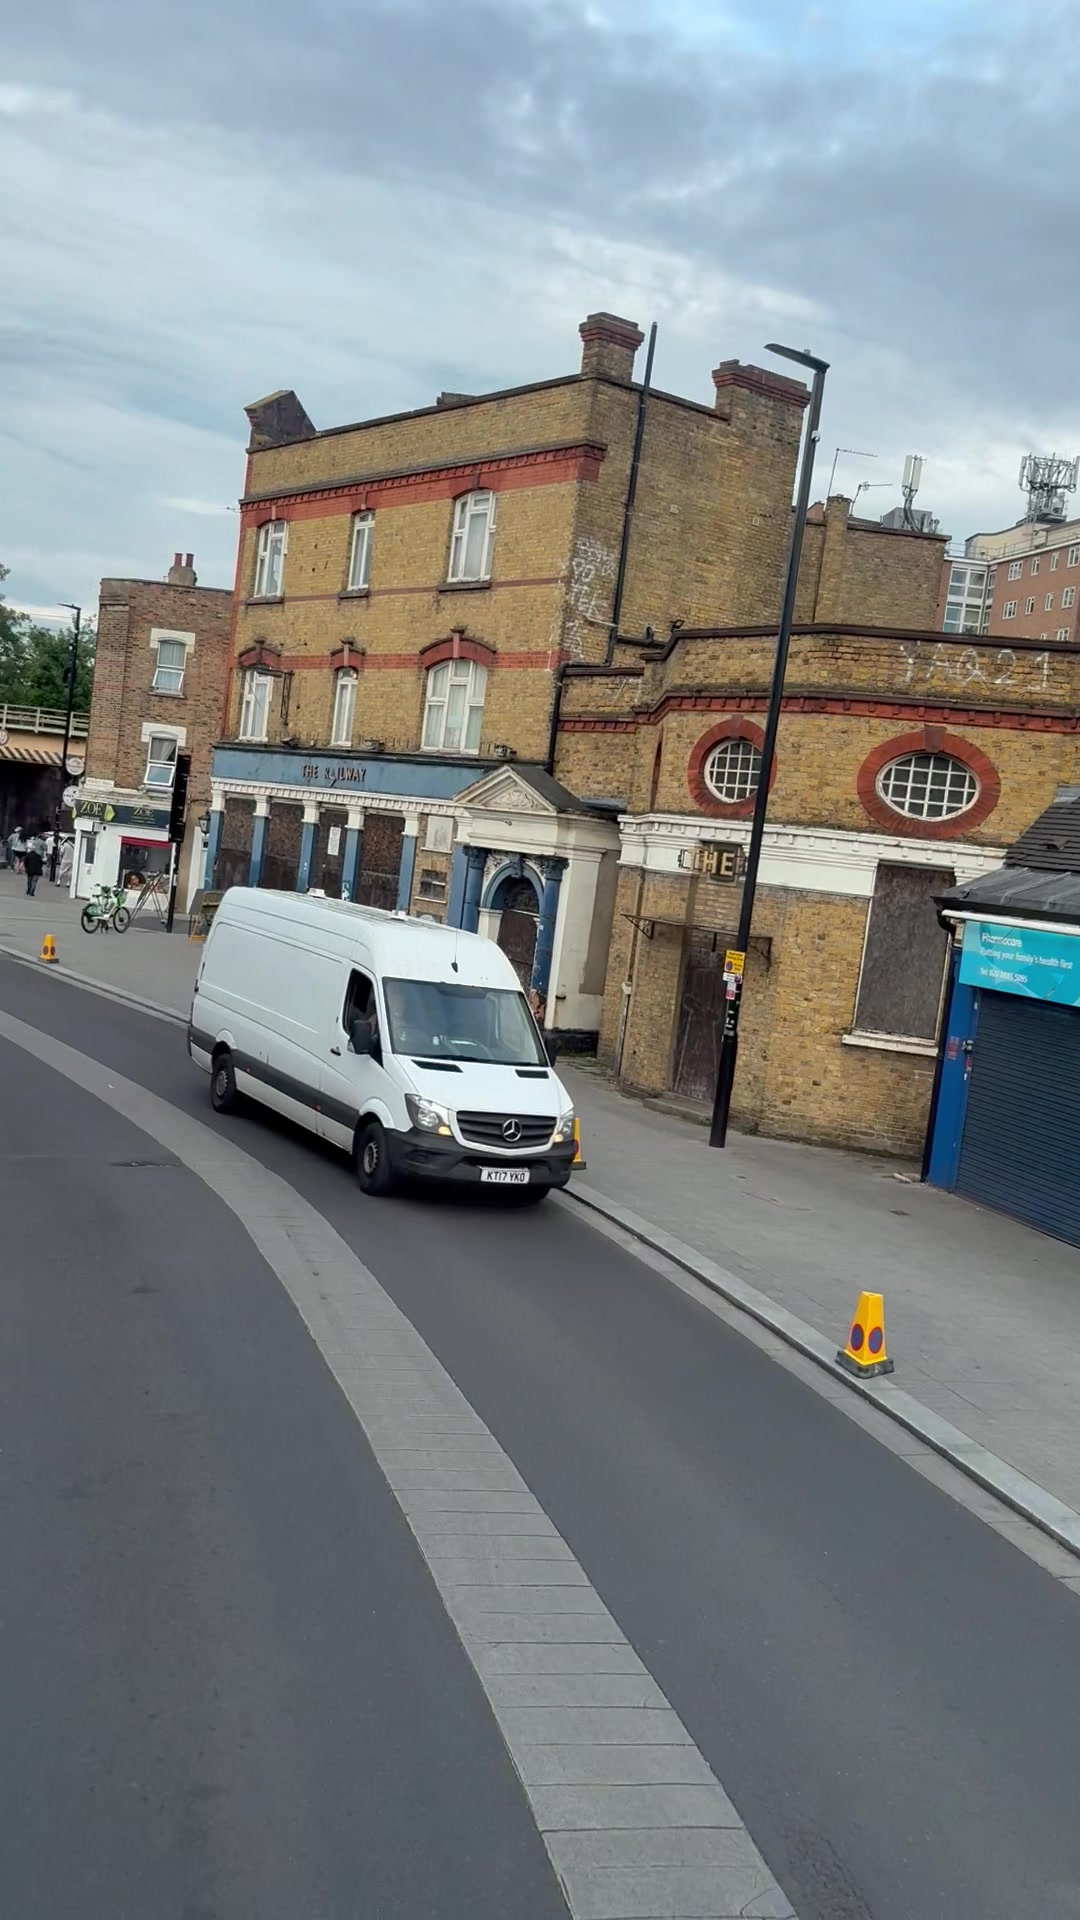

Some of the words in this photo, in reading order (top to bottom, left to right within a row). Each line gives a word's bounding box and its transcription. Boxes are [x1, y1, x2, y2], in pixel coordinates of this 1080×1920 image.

[303, 765, 319, 779] THE
[80, 801, 103, 816] ZOE
[133, 807, 154, 817] ZOE
[687, 847, 736, 876] THE
[1001, 951, 1014, 960] your
[1015, 951, 1038, 965] family's
[1039, 955, 1059, 967] health
[1060, 958, 1073, 970] first
[487, 1171, 507, 1181] KT17
